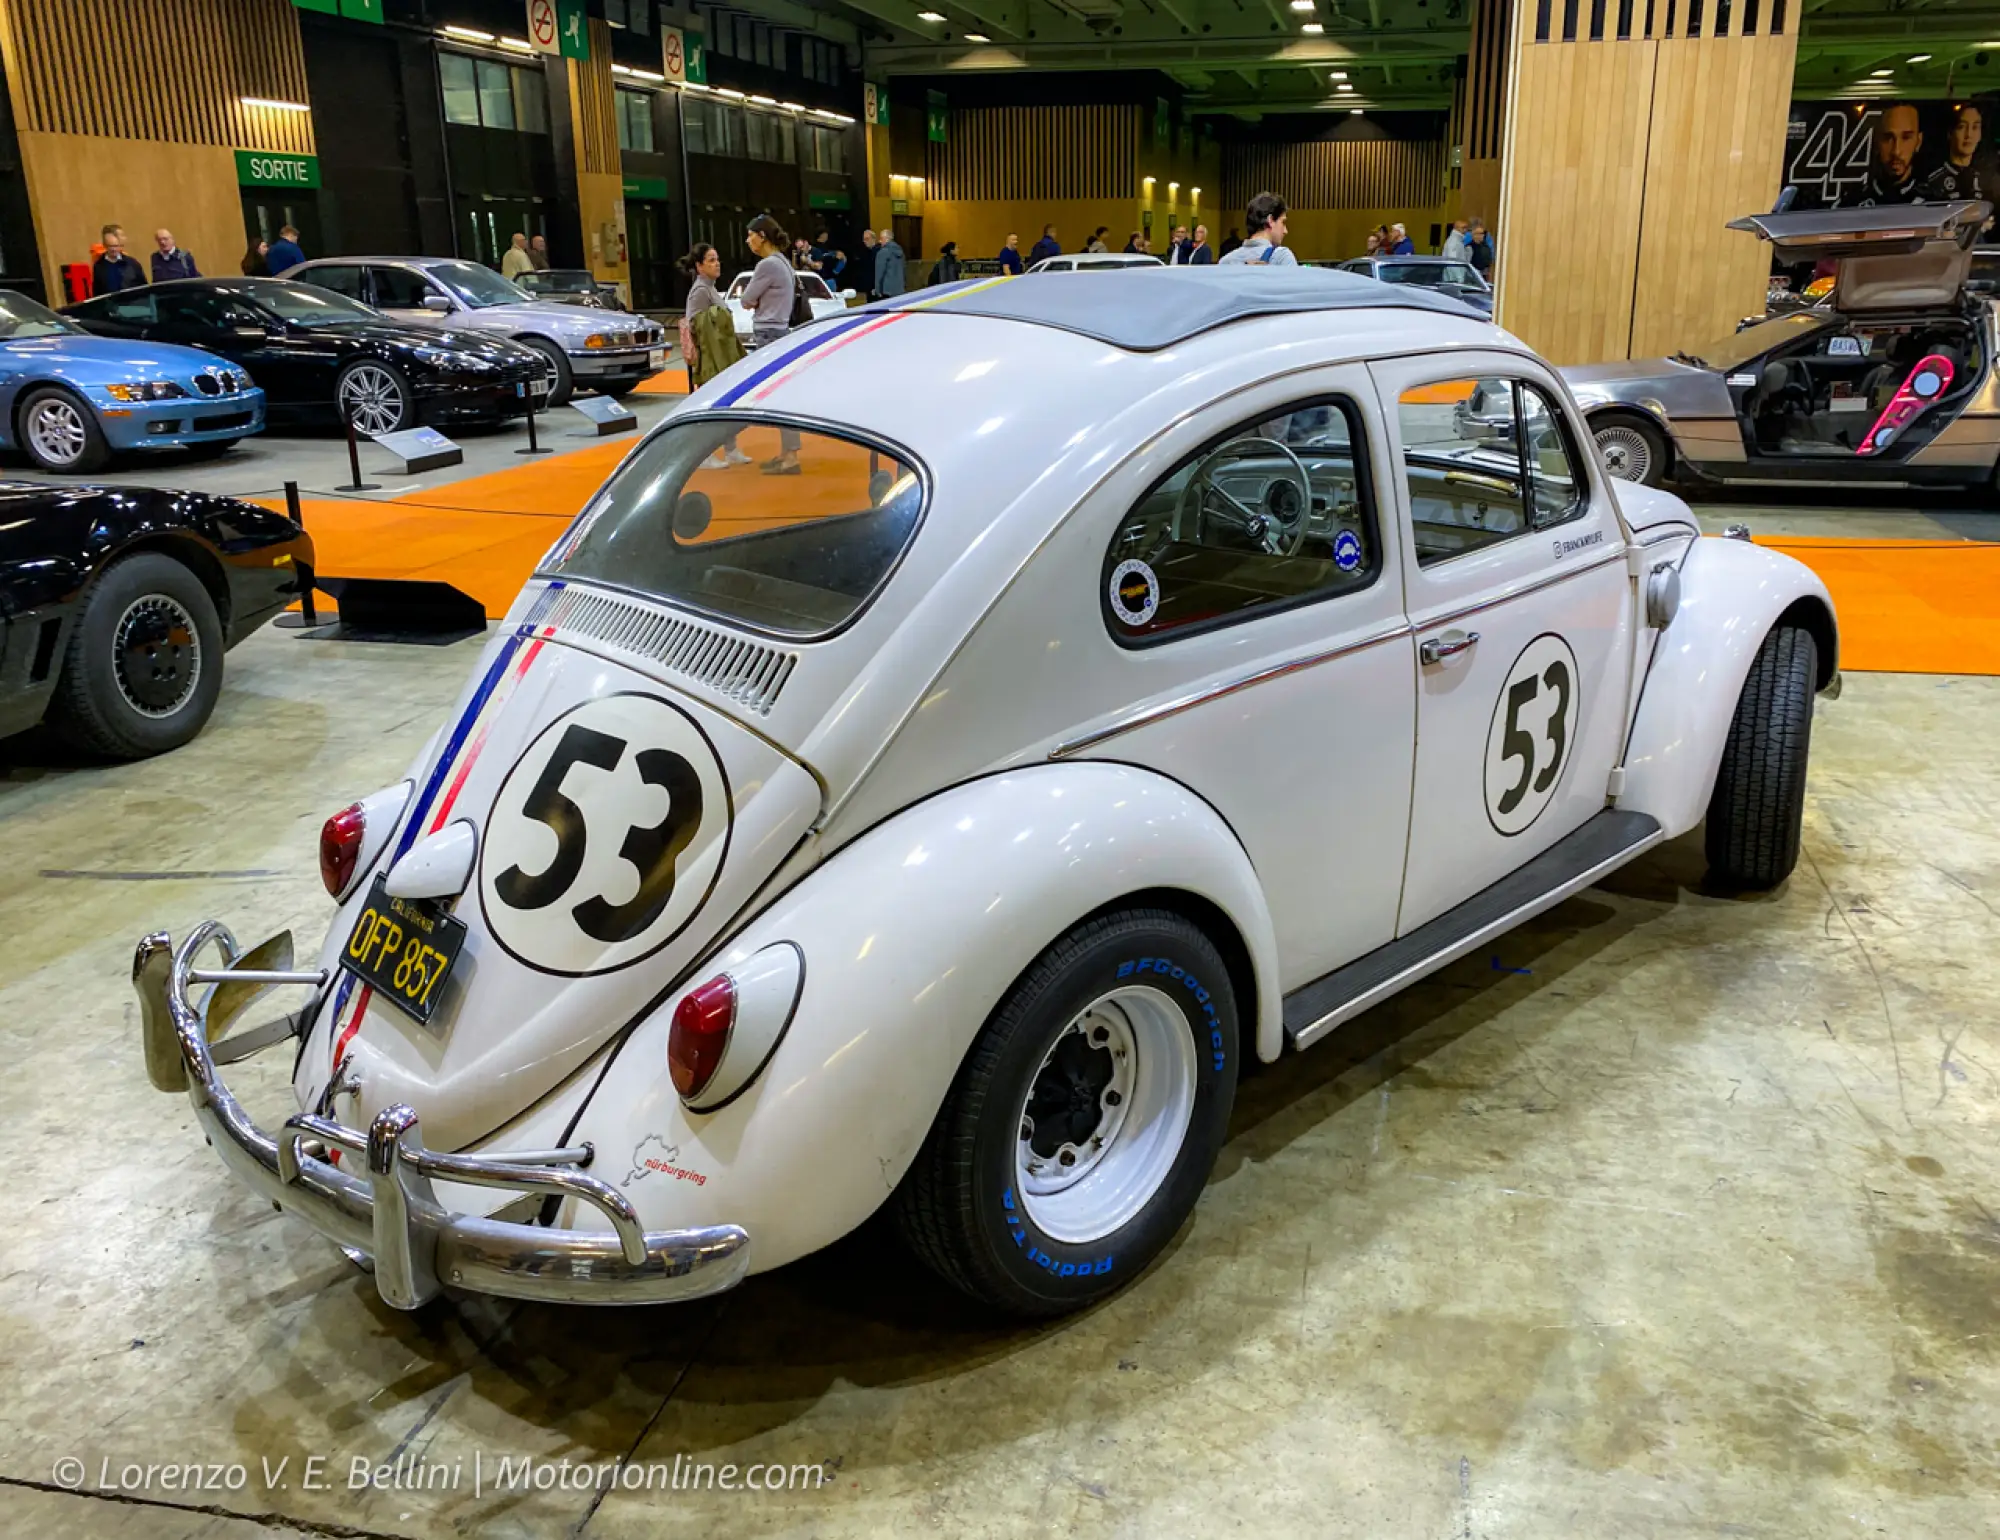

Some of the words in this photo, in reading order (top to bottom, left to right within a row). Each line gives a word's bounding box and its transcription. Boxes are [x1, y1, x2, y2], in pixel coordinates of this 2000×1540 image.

[250, 158, 309, 181] SORTIE
[1789, 111, 1883, 200] 44
[1497, 660, 1570, 815] 53
[494, 724, 704, 943] 53
[393, 938, 448, 1006] 857
[1116, 957, 1224, 1071] BFGoodrich
[644, 1158, 707, 1186] nürburgring
[1027, 1247, 1112, 1276] Radial
